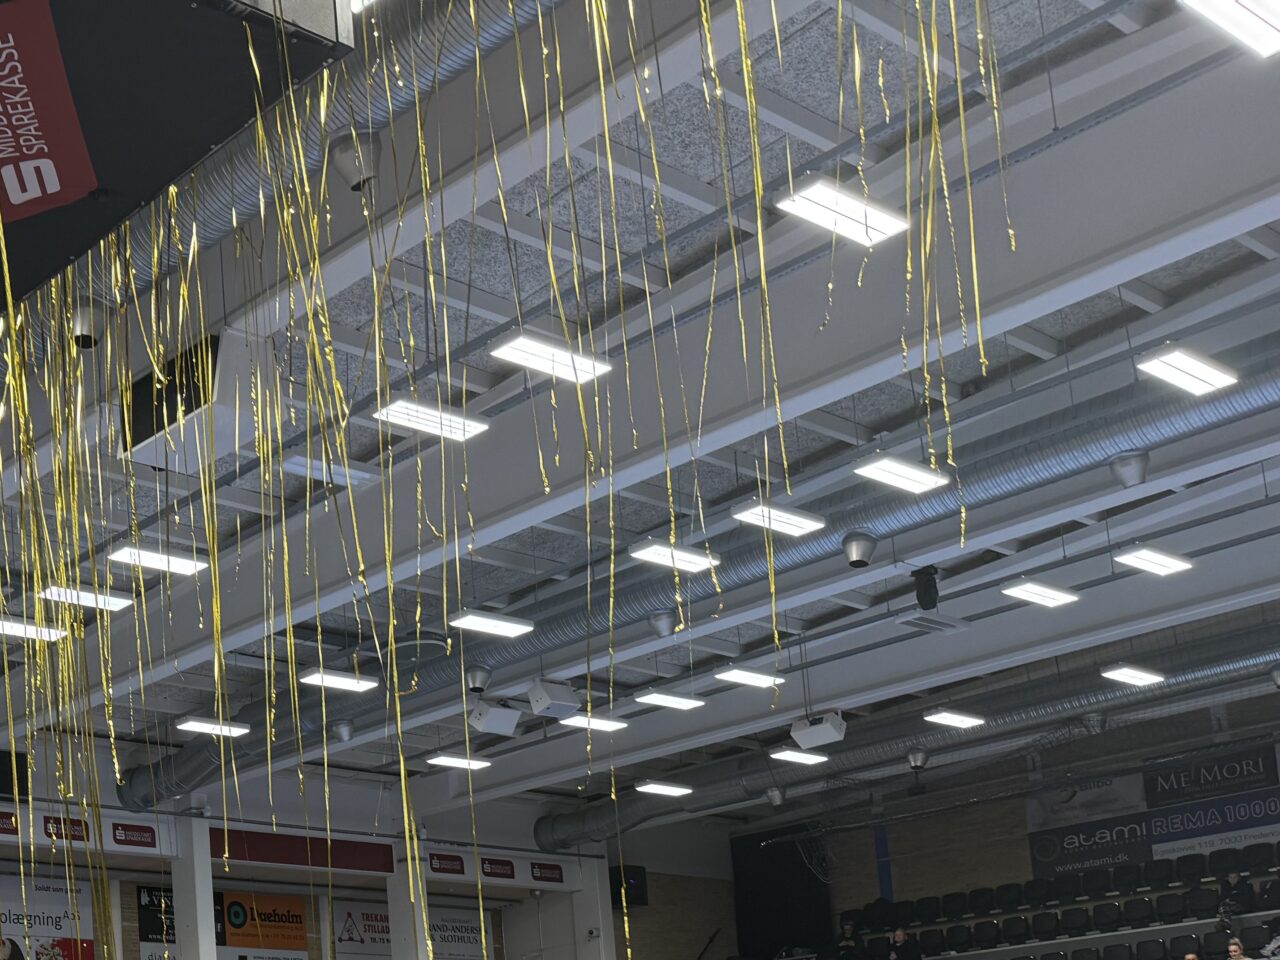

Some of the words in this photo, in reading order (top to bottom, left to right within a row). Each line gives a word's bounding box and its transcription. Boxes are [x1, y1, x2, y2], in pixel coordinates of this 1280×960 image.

[1152, 805, 1221, 836] REMA
[1225, 796, 1280, 823] 1000
[1063, 821, 1147, 849] atami
[1055, 853, 1130, 873] www.atami.dk
[249, 907, 303, 925] Dueholm
